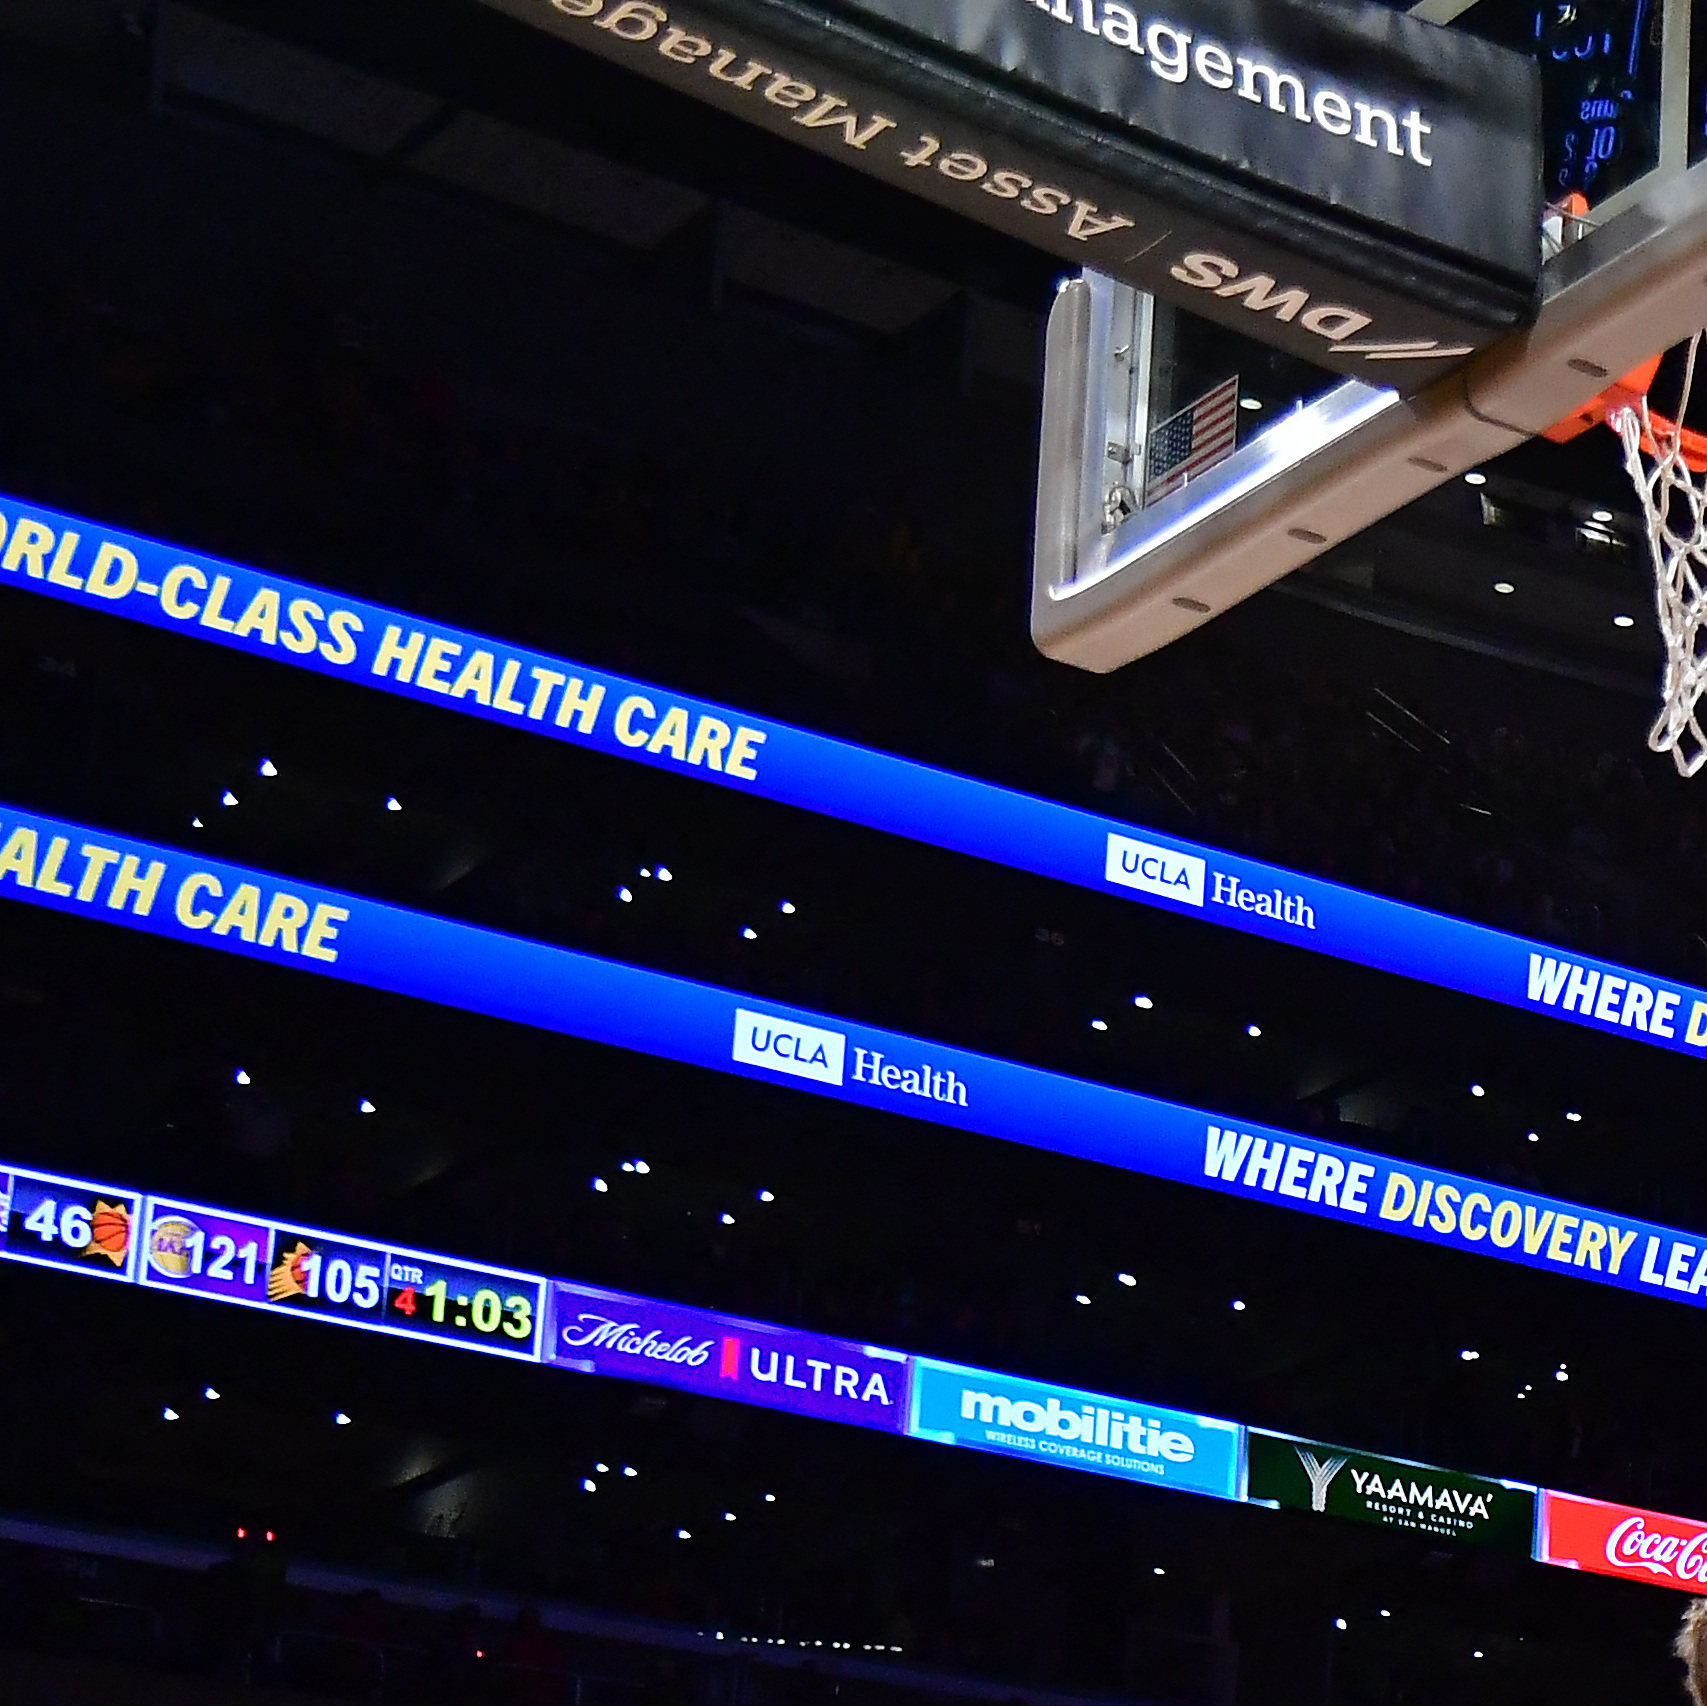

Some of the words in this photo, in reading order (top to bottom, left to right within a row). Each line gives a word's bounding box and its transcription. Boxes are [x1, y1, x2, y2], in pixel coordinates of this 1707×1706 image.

[1028, 0, 1433, 167] nagement
[900, 135, 1135, 242] Asset
[0, 510, 363, 665] RLD-CLASS
[371, 626, 605, 734] HEALTH
[614, 695, 766, 780] CARE
[0, 826, 167, 917] ALTH
[176, 870, 349, 962] CARE
[1121, 850, 1191, 891] UCLA
[1211, 872, 1316, 930] Health
[1528, 952, 1681, 1038] WHERE
[751, 1026, 829, 1069] UCLA
[852, 1047, 969, 1108] Health
[25, 1199, 92, 1248] 46
[1203, 1125, 1375, 1214] WHERE
[1378, 1172, 1639, 1276] DISCOVERY
[184, 1231, 258, 1285] 121
[301, 1256, 380, 1309] 105
[390, 1264, 423, 1285] QTR
[394, 1287, 416, 1316] 4
[425, 1280, 532, 1339] 1:03
[562, 1314, 715, 1367] Michelob
[750, 1347, 893, 1406] ULTRA
[961, 1388, 1194, 1463] mobilitie
[985, 1430, 1036, 1451] WIRELESS
[1039, 1440, 1102, 1465] COVERAGE
